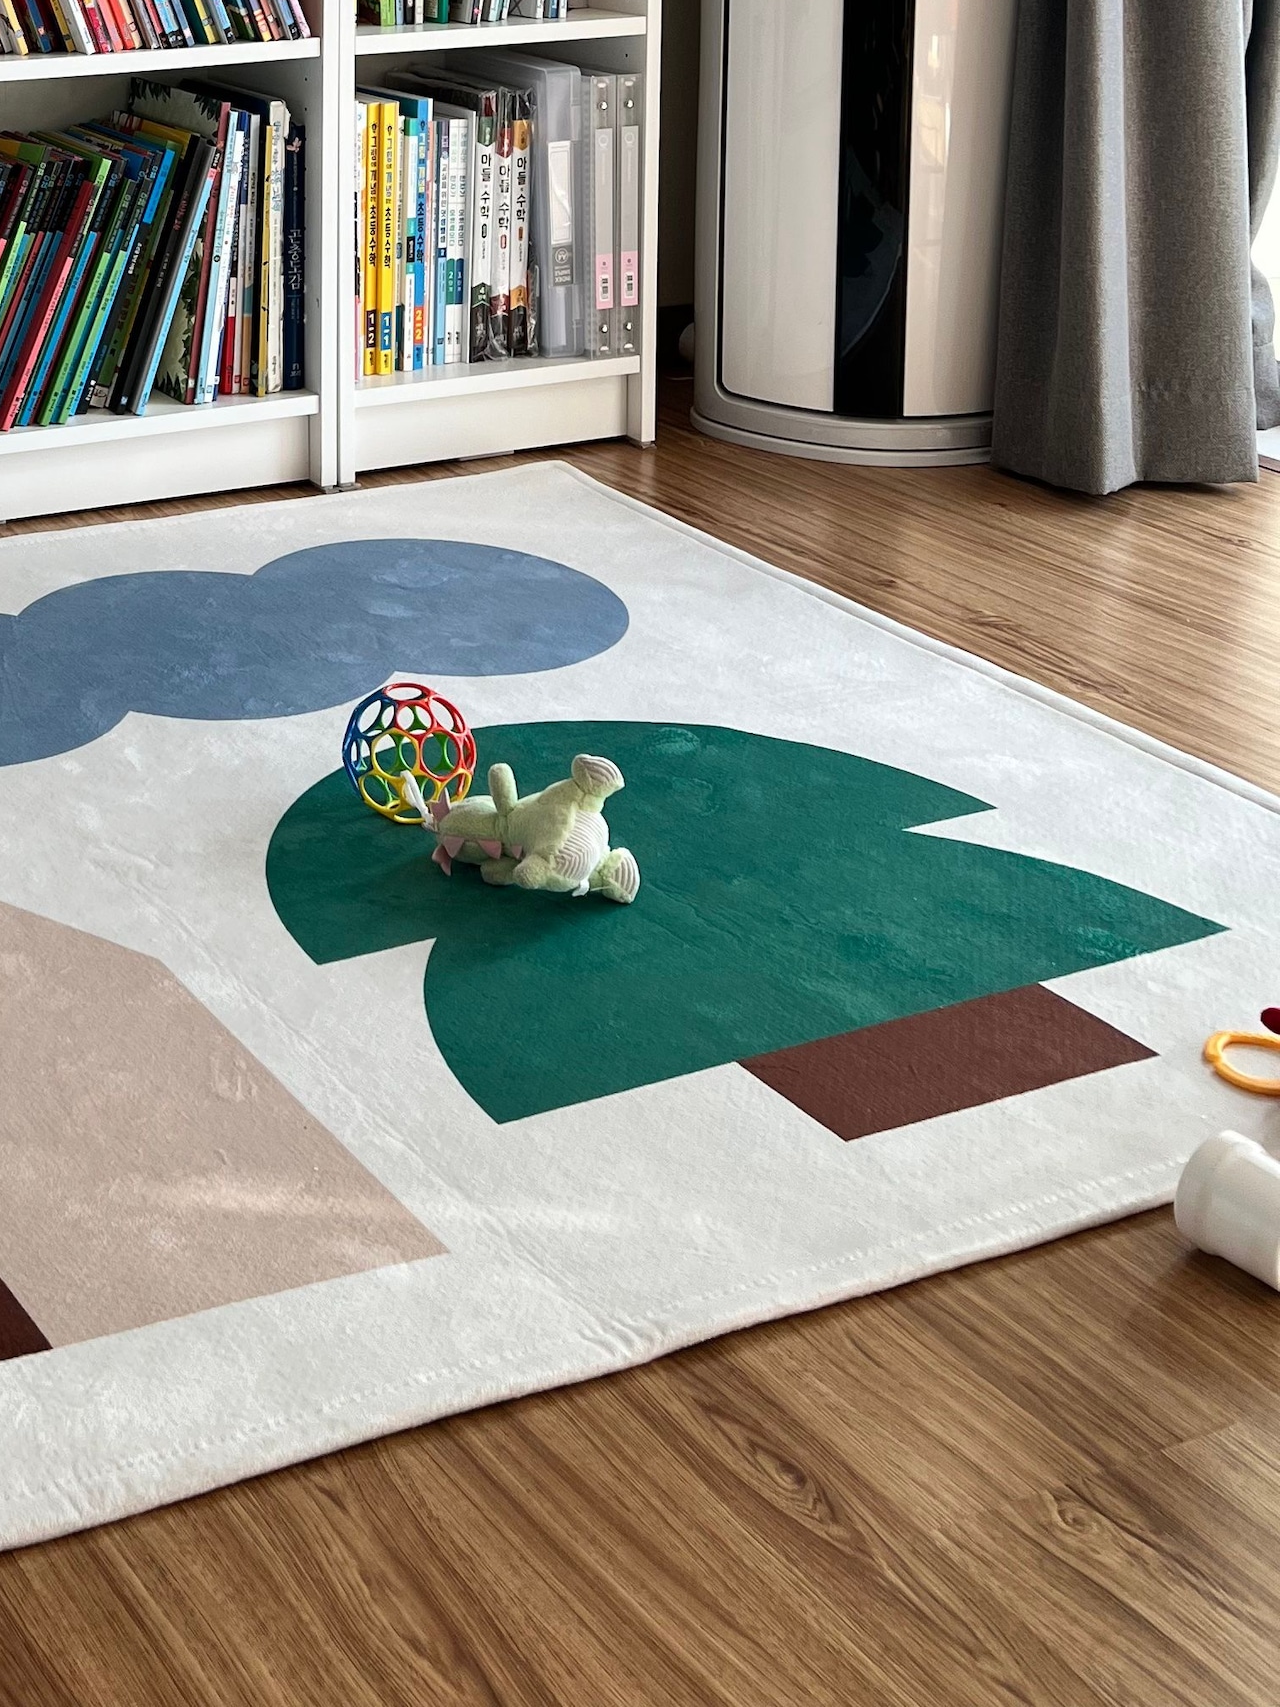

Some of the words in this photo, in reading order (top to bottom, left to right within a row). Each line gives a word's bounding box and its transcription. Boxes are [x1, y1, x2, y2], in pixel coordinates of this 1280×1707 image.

[479, 190, 491, 220] 수학
[498, 201, 510, 231] 수학
[515, 193, 526, 223] 수학
